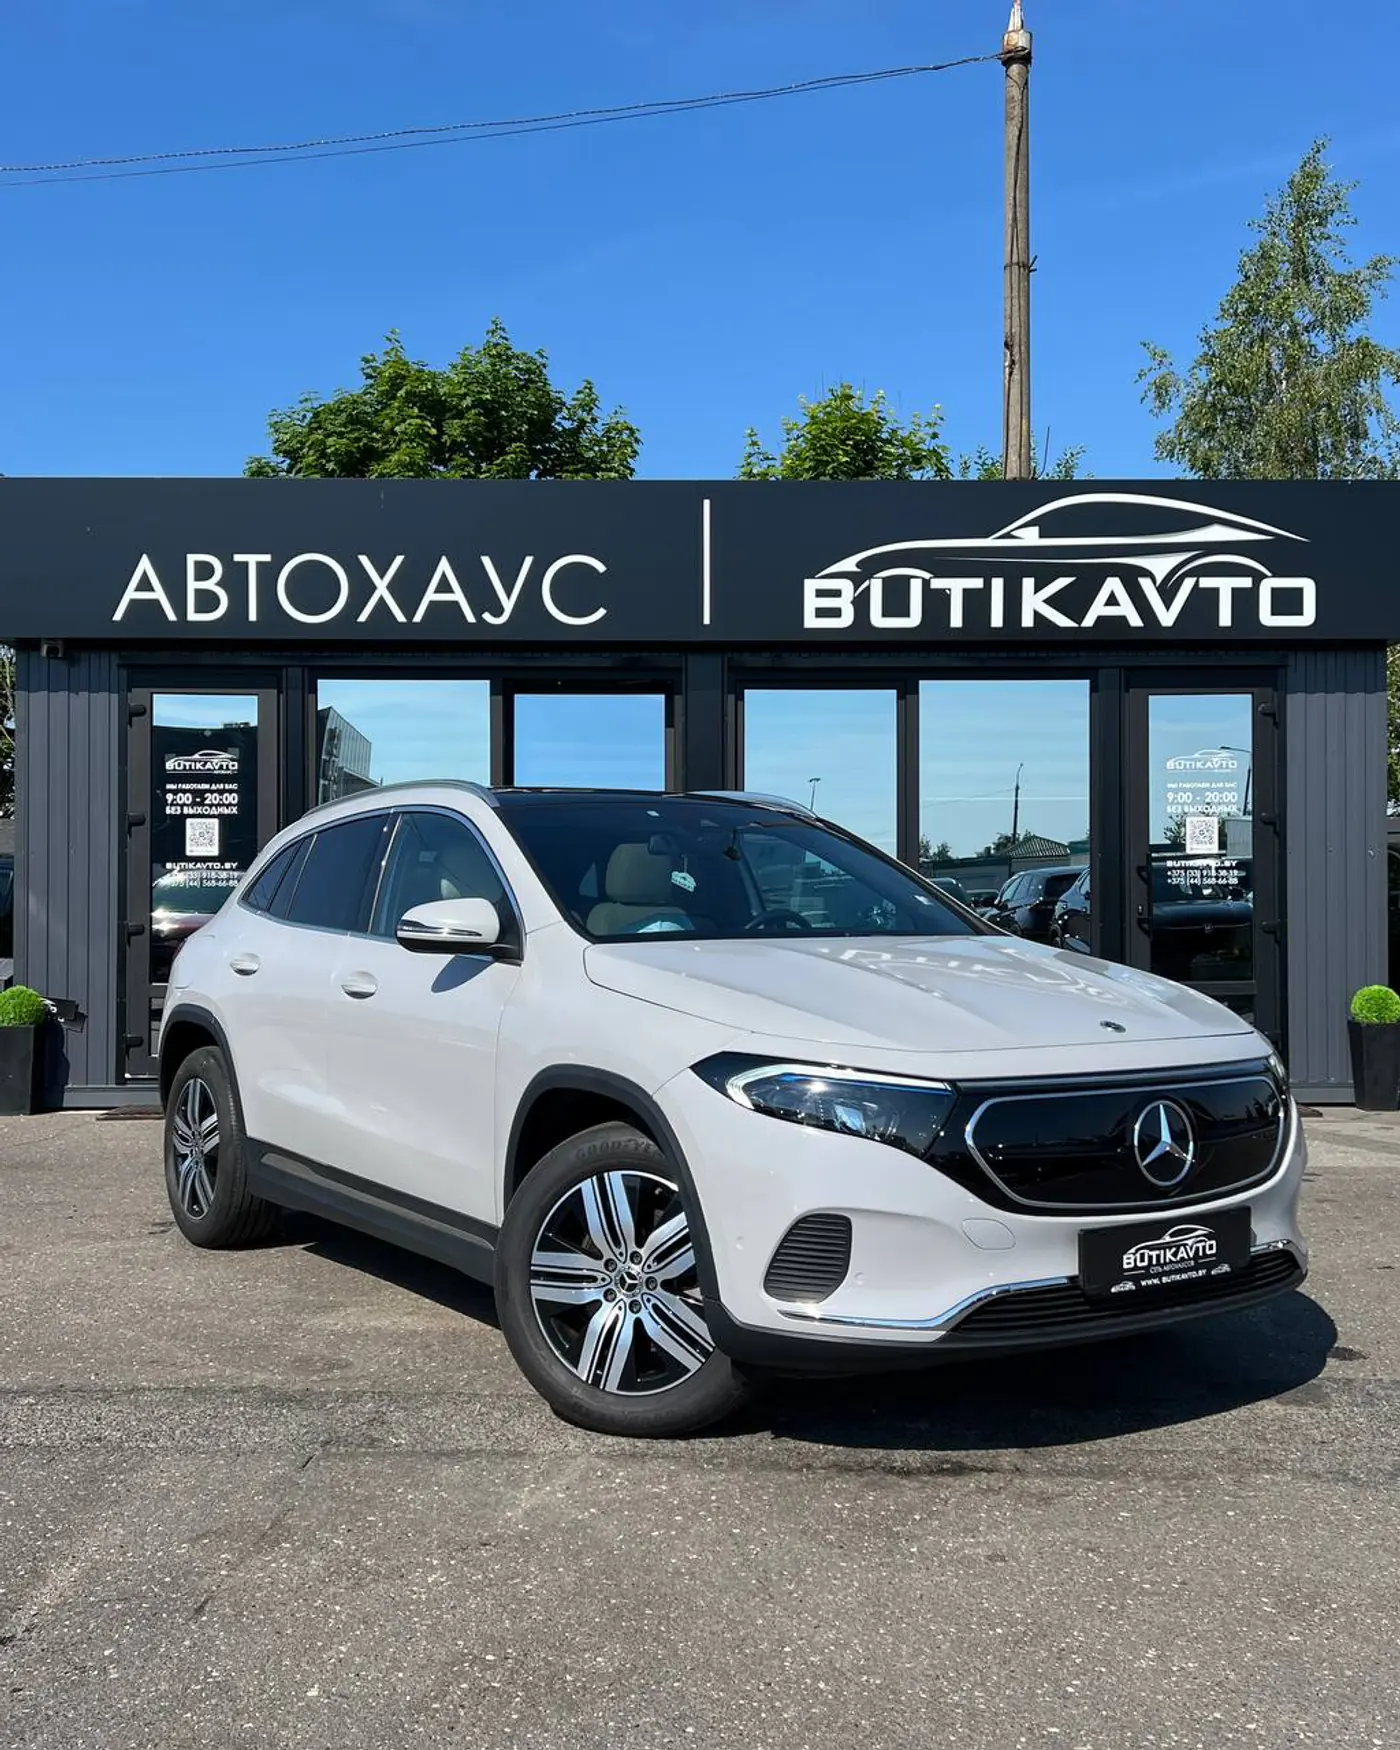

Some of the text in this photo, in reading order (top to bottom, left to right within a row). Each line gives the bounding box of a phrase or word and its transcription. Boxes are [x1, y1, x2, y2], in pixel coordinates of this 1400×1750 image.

[112, 552, 607, 626] АВТОХАУС
[803, 576, 1317, 629] BUTIKAVTO
[165, 761, 239, 770] BUTIKAVTO
[1166, 760, 1238, 770] BUTIKAVTO
[165, 792, 193, 805] 9:00
[204, 792, 239, 805] 20:00
[1166, 791, 1193, 804] 9:00
[1204, 791, 1238, 803] 20:00
[165, 805, 239, 816] БЕЗ ВЫХОДНЫХ
[165, 862, 239, 870] BUTIKAVTO.BY
[1122, 1239, 1217, 1269] BUTIKAVTO
